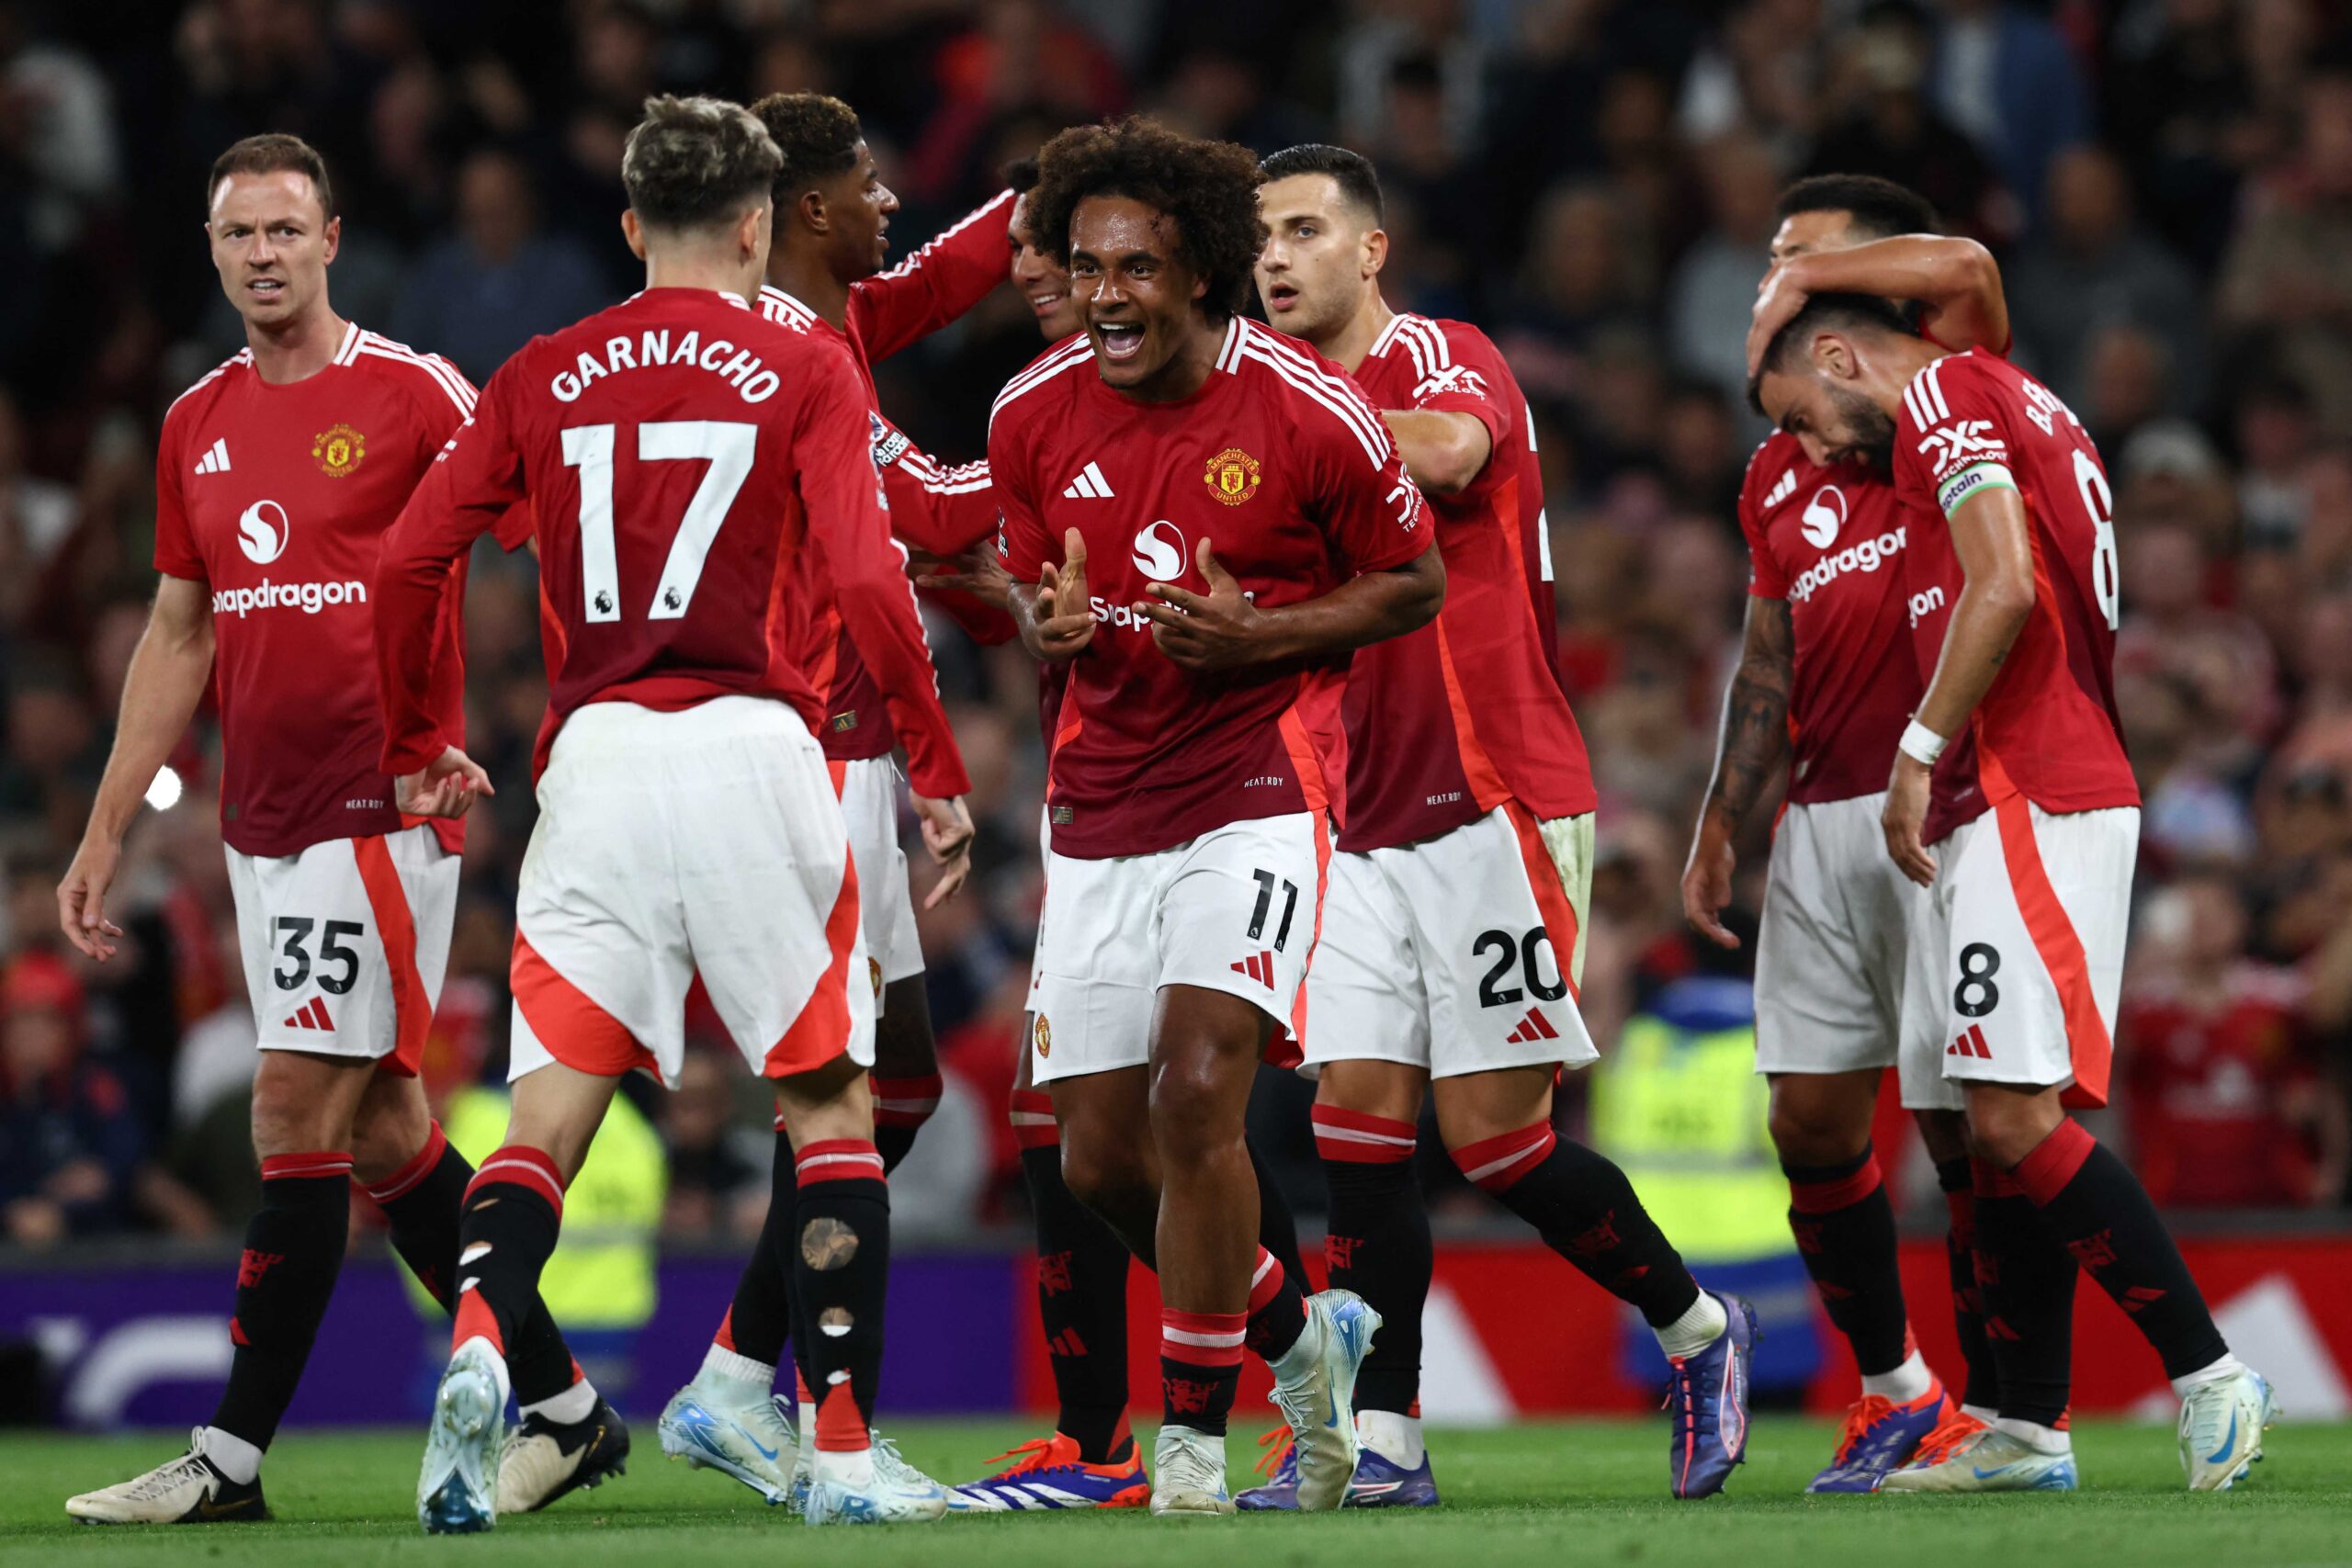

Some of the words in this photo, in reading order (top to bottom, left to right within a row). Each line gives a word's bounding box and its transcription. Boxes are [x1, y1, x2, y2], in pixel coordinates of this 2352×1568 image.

[551, 329, 780, 403] GARNACHO
[1210, 452, 1256, 472] MANCHESTER
[1216, 491, 1249, 502] UNITED
[560, 420, 758, 623] 17
[1403, 494, 1423, 533] TECHNO
[2072, 448, 2119, 631] 8
[1244, 776, 1283, 788] HEAT.RDY
[1426, 792, 1462, 806] HEAT.RDY
[1247, 868, 1298, 953] 11
[274, 917, 363, 995] 35
[1473, 927, 1567, 1008] 20
[1954, 942, 2000, 1017] 8
